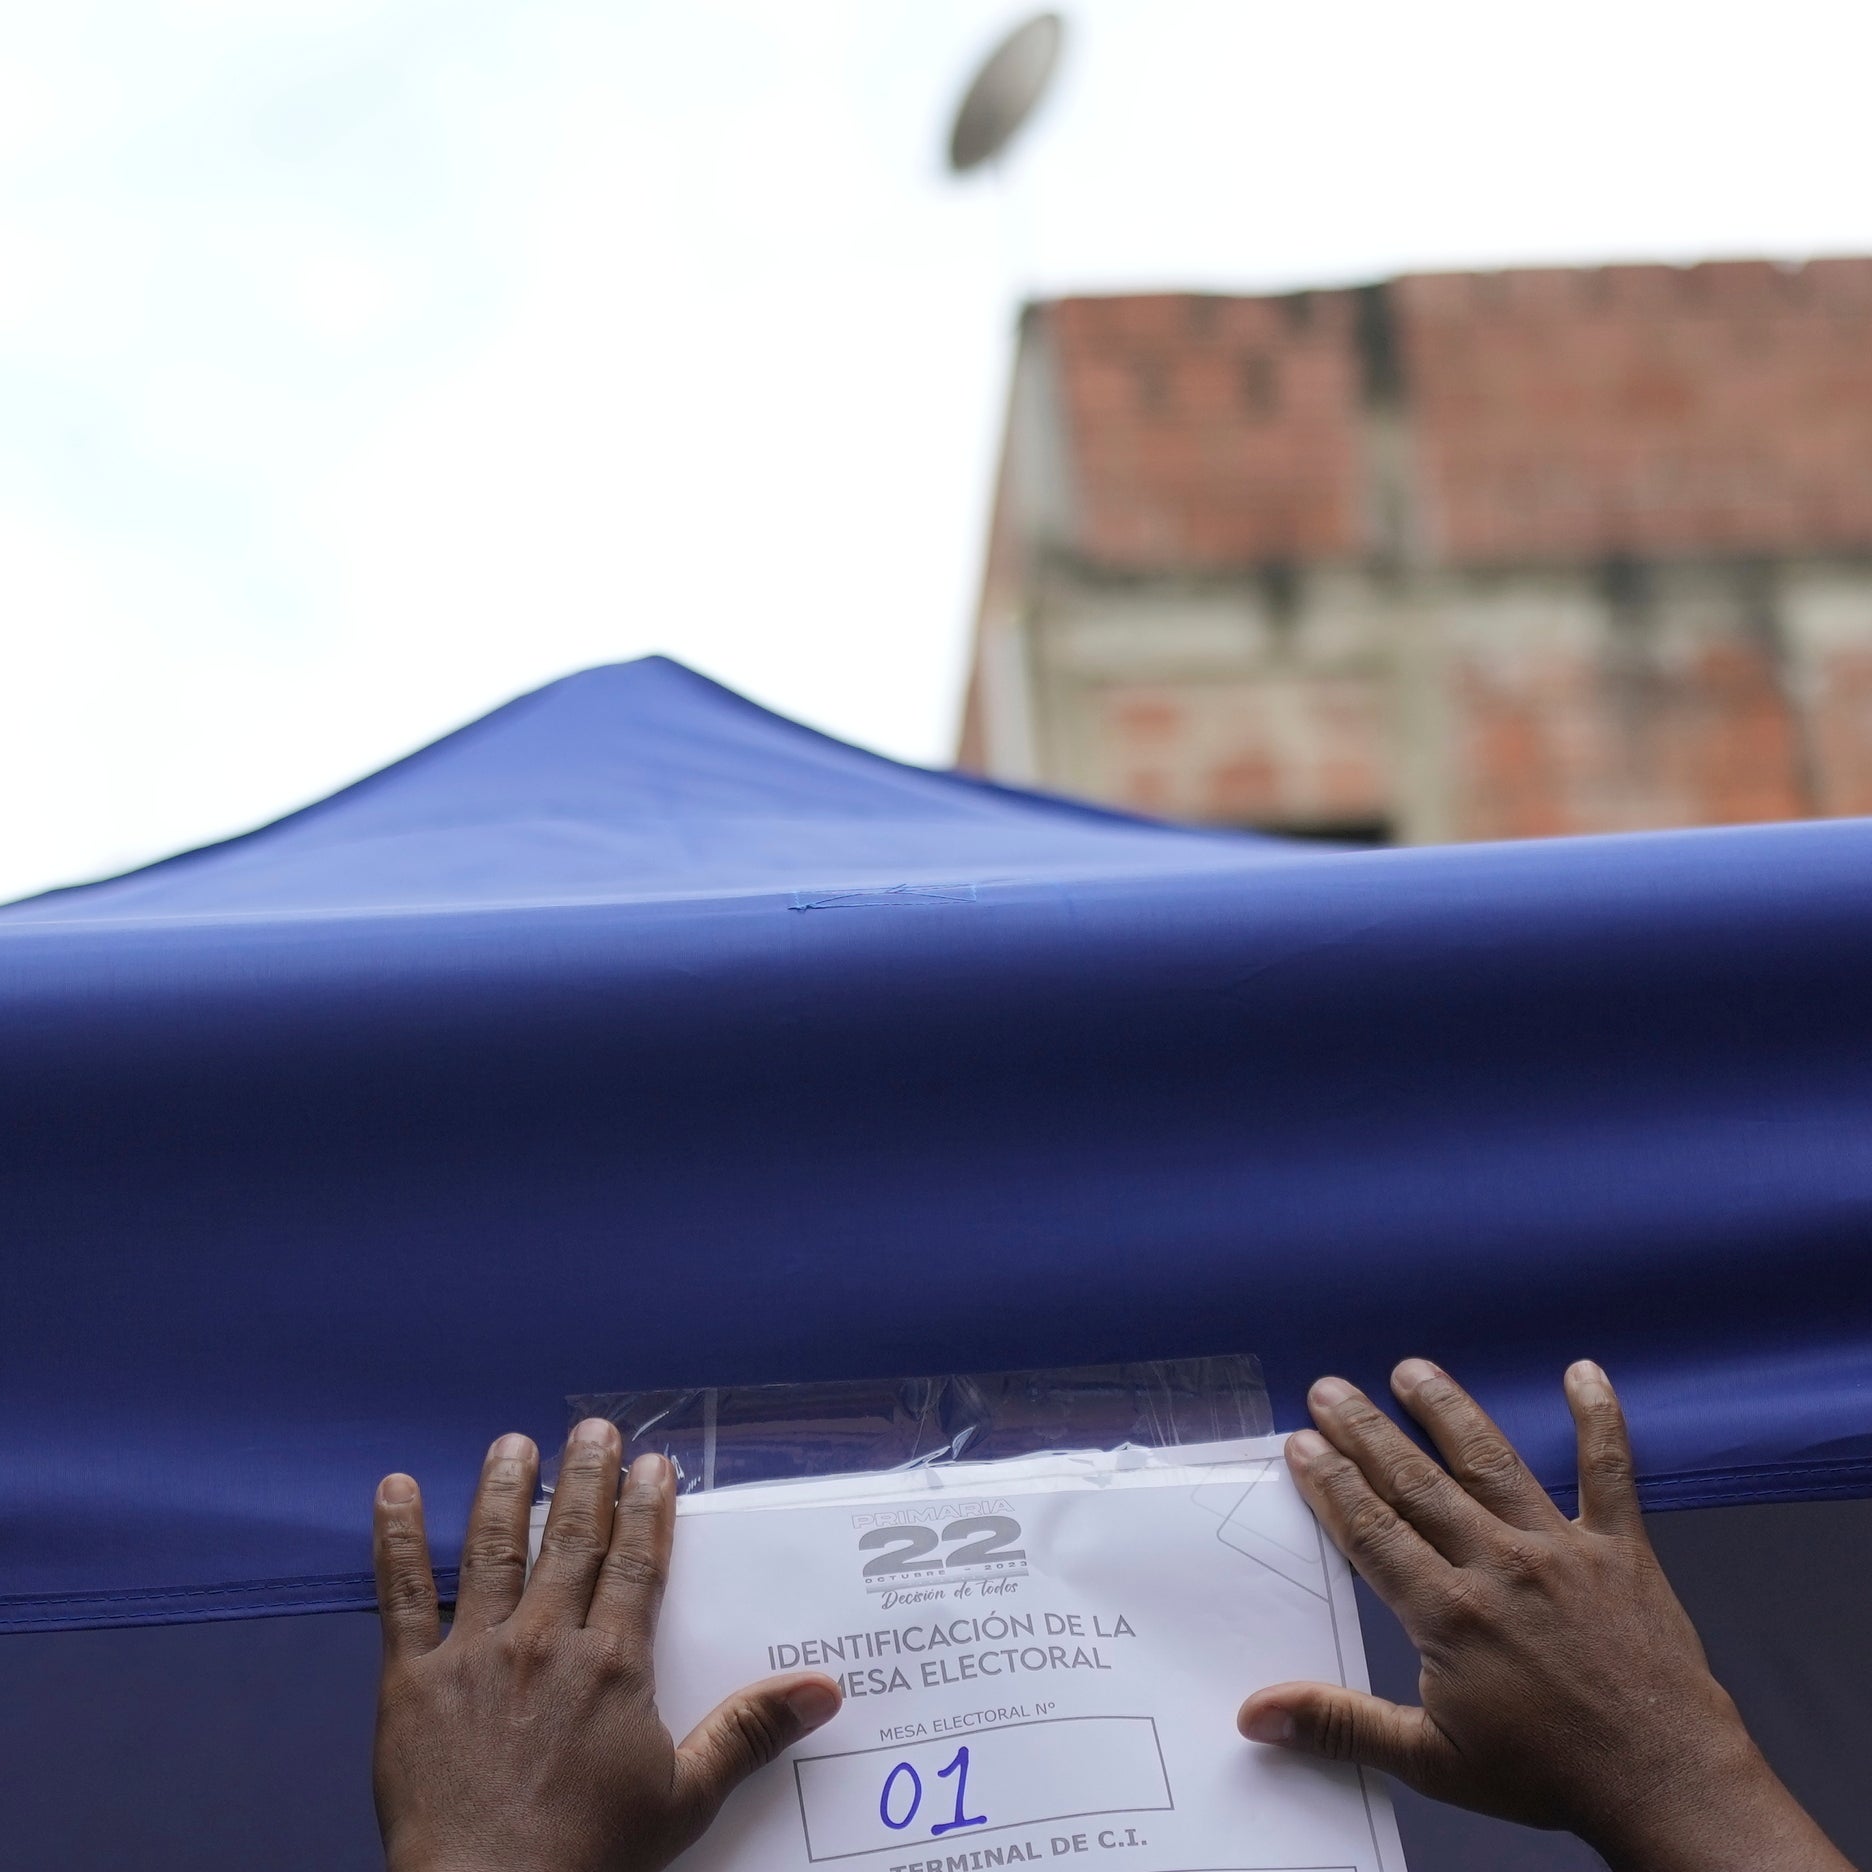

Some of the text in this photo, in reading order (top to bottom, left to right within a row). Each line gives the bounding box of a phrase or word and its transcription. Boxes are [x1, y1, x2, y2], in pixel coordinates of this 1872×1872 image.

[851, 1498, 1015, 1529] PRIMARIA
[859, 1515, 1026, 1577] 22
[865, 1570, 946, 1584] OCTUBRE
[985, 1561, 1028, 1571] 2023
[881, 1588, 946, 1610] Decisión
[954, 1581, 973, 1599] de
[768, 1610, 1136, 1670] IDENTIFICACIÓN DE LA
[920, 1645, 1112, 1688] ELECTORAL
[879, 1724, 927, 1742] MESA
[933, 1704, 1031, 1733] ELECTORAL
[879, 1746, 987, 1836] 01
[1051, 1833, 1088, 1857] DE
[1097, 1828, 1148, 1849] C.I.
